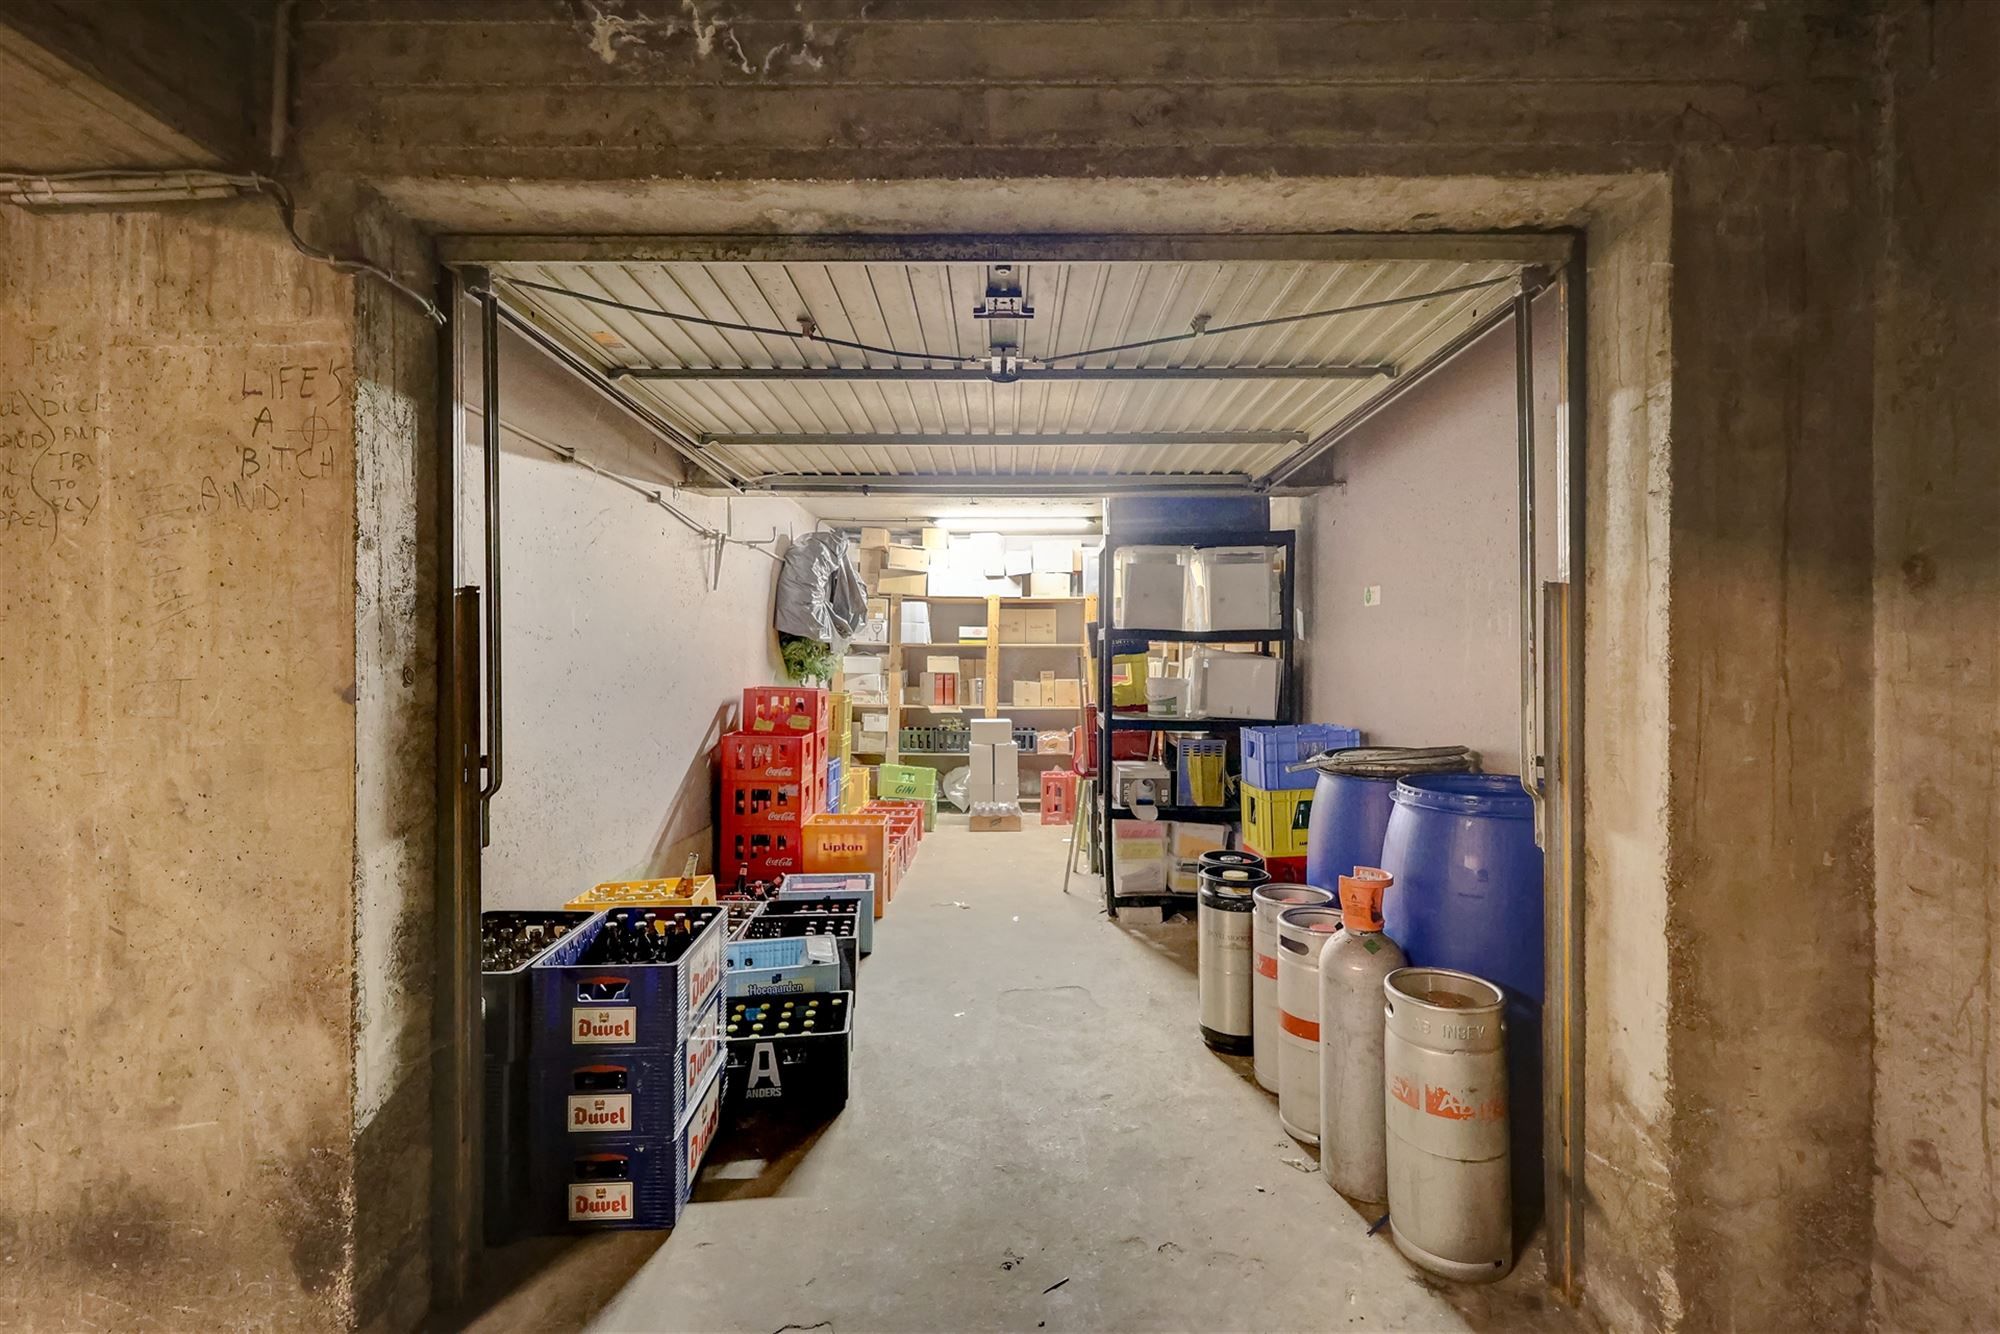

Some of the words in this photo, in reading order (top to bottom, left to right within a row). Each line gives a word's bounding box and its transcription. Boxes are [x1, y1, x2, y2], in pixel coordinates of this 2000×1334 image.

[242, 359, 346, 407] LIFE'S
[252, 406, 273, 438] A
[241, 445, 334, 480] BITCH
[49, 478, 76, 491] TO
[201, 475, 281, 514] AND
[895, 784, 917, 794] GINI
[823, 842, 863, 853] Lipton
[748, 980, 804, 996] Hoegaarden
[578, 1018, 630, 1037] Duvel
[1442, 1024, 1487, 1041] INBEV
[745, 1087, 782, 1099] ANDERS
[574, 1106, 626, 1125] Duvel
[575, 1195, 628, 1213] Duvel
